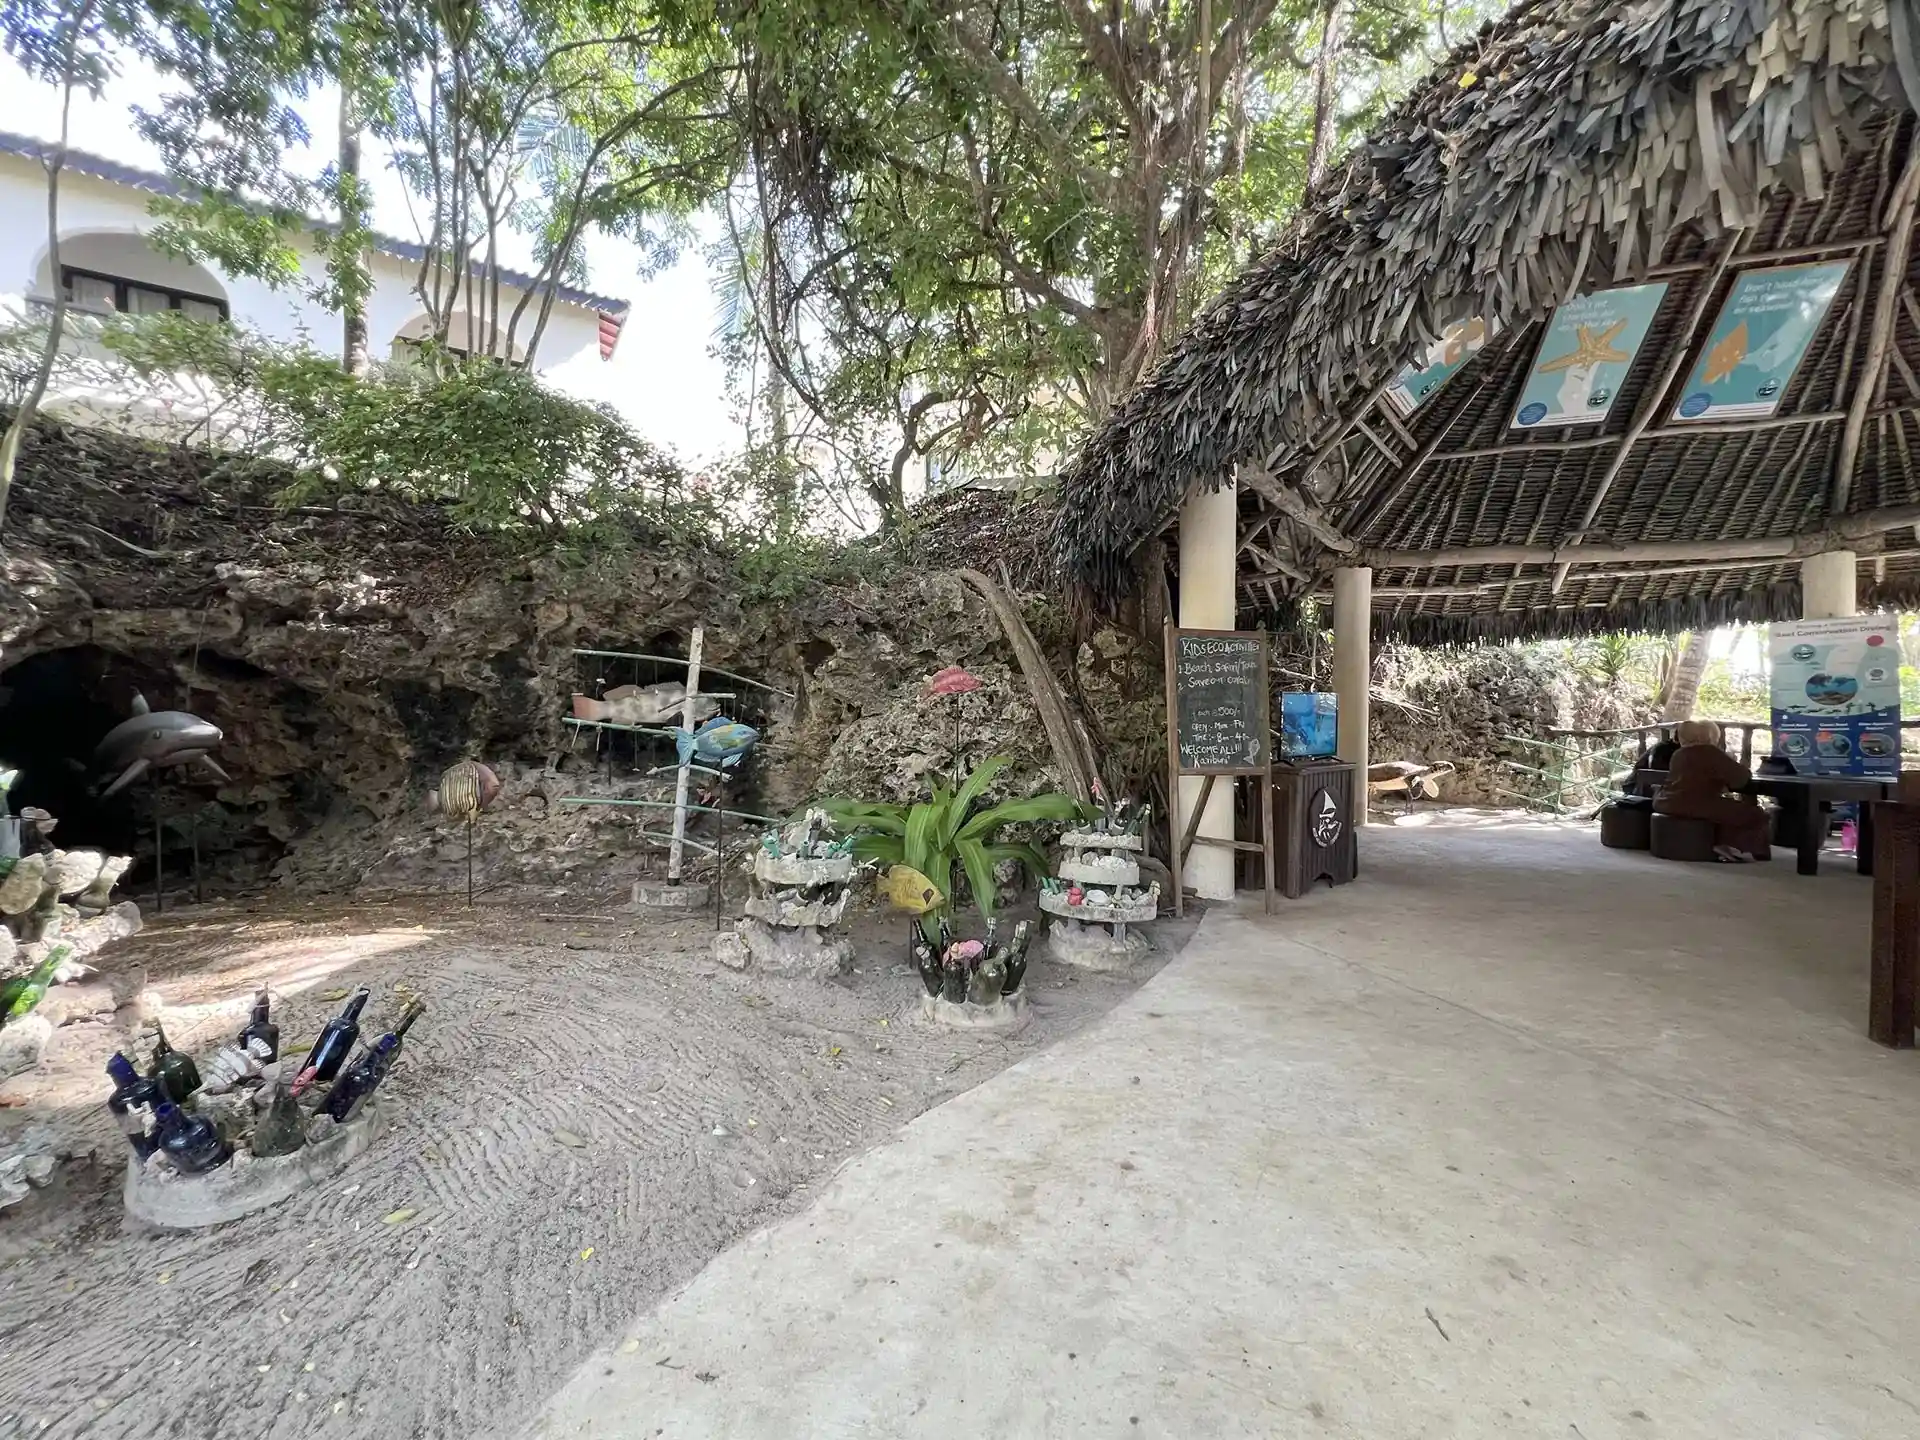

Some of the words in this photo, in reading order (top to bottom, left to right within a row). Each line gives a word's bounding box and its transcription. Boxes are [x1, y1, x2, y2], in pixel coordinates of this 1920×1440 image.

[1182, 640, 1206, 656] KIDS
[1207, 642, 1224, 654] ECO
[1184, 660, 1213, 675] Beach
[1187, 676, 1210, 688] Save
[1180, 742, 1219, 757] WELCOME
